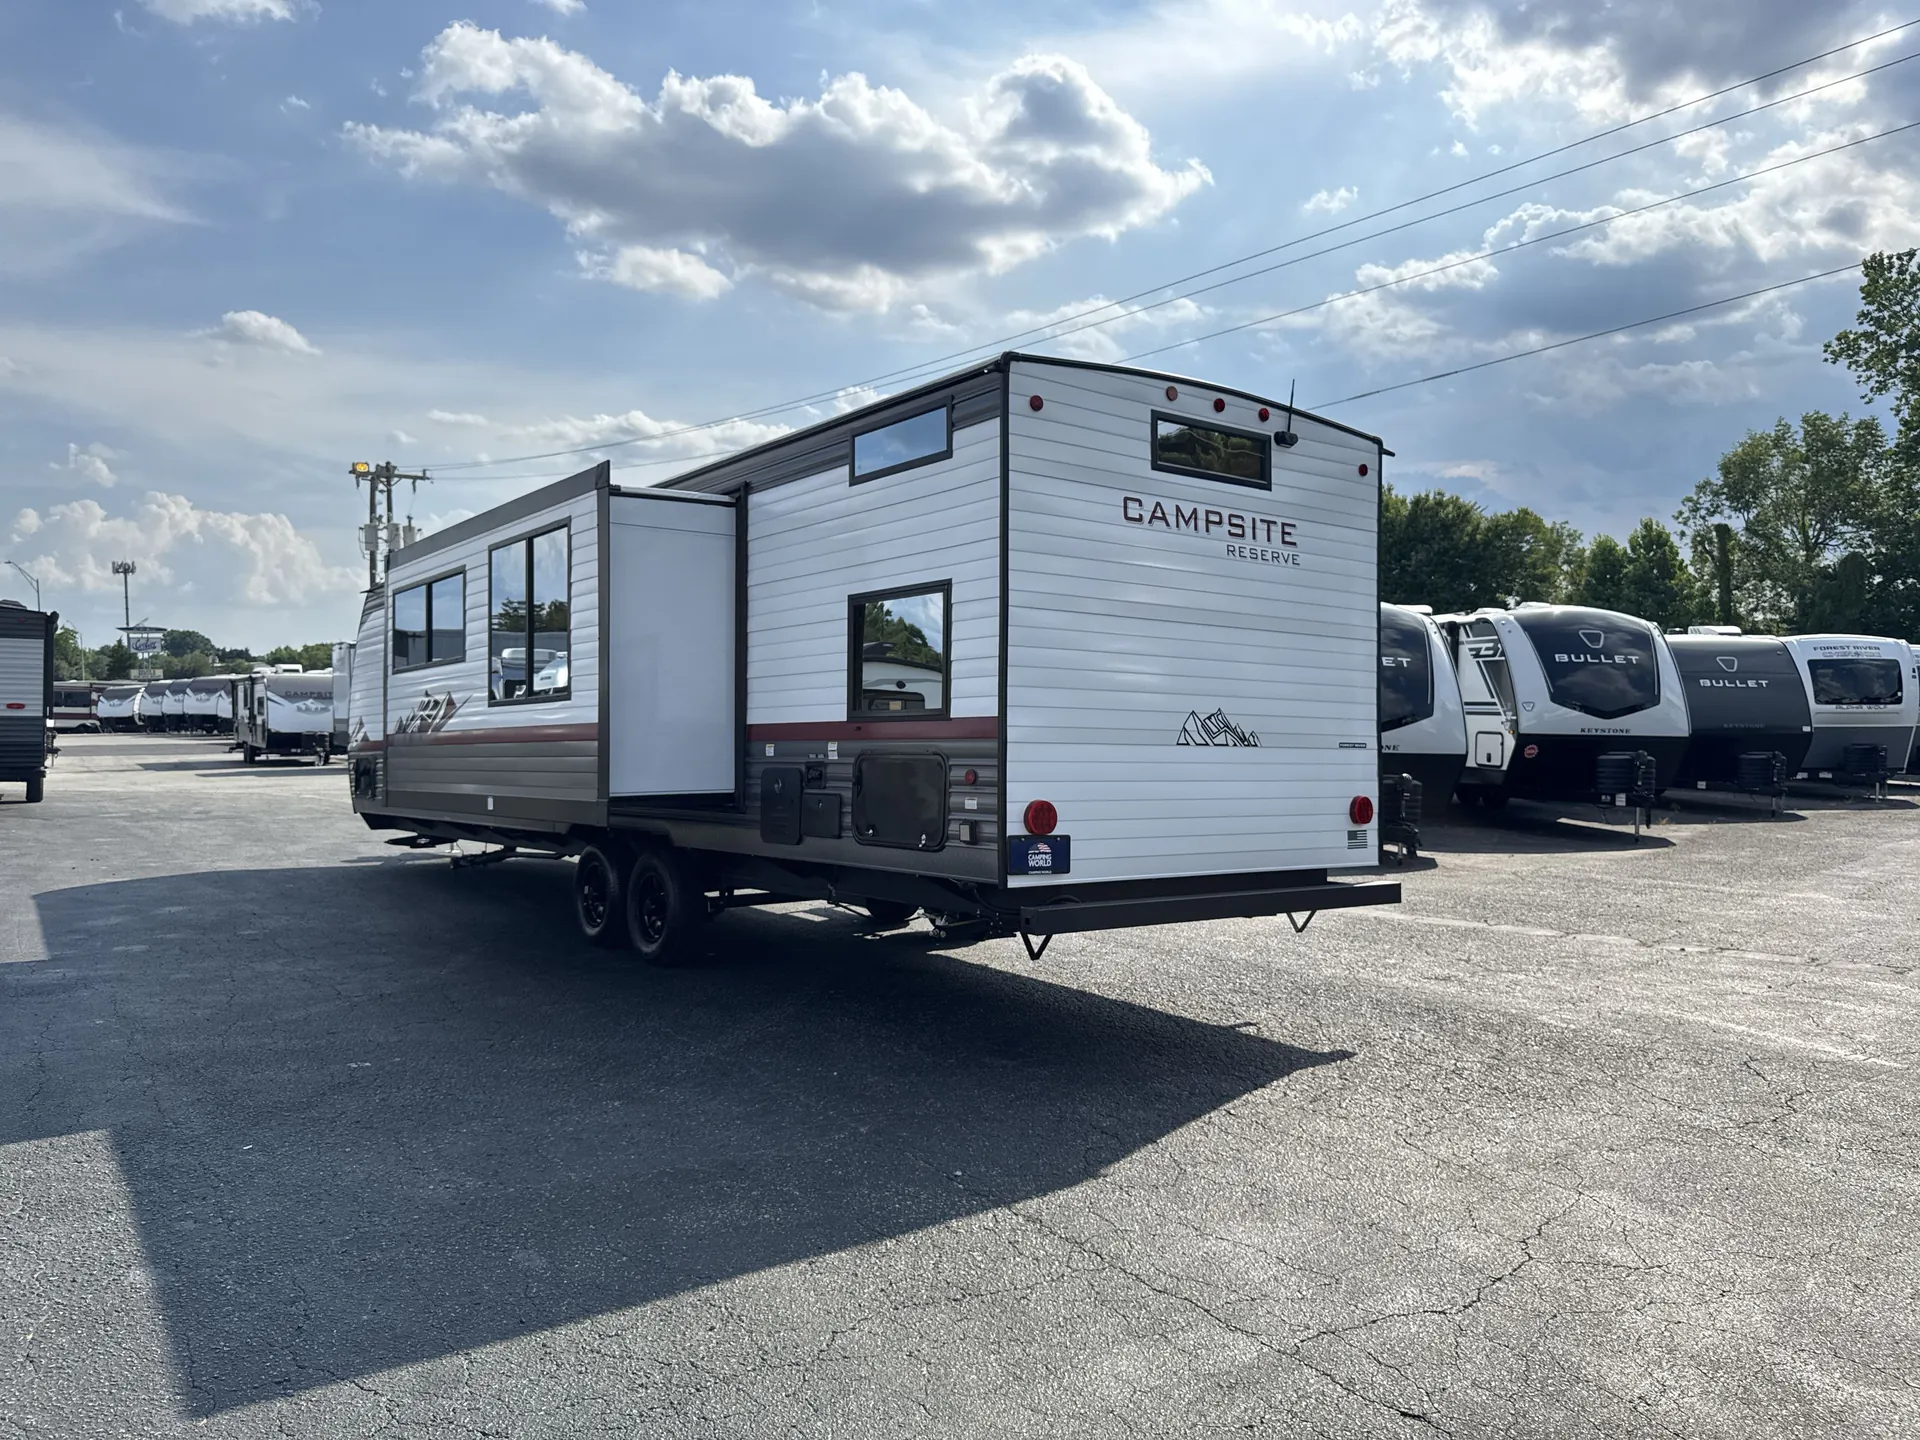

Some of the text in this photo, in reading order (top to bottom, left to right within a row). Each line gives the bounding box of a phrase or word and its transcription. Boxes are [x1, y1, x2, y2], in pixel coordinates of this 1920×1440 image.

[1123, 496, 1297, 547] CAMPSITE
[1226, 544, 1301, 566] RESERVE
[1554, 653, 1640, 664] BULLET
[1699, 679, 1769, 688] BULLET
[1028, 859, 1051, 867] WORLD
